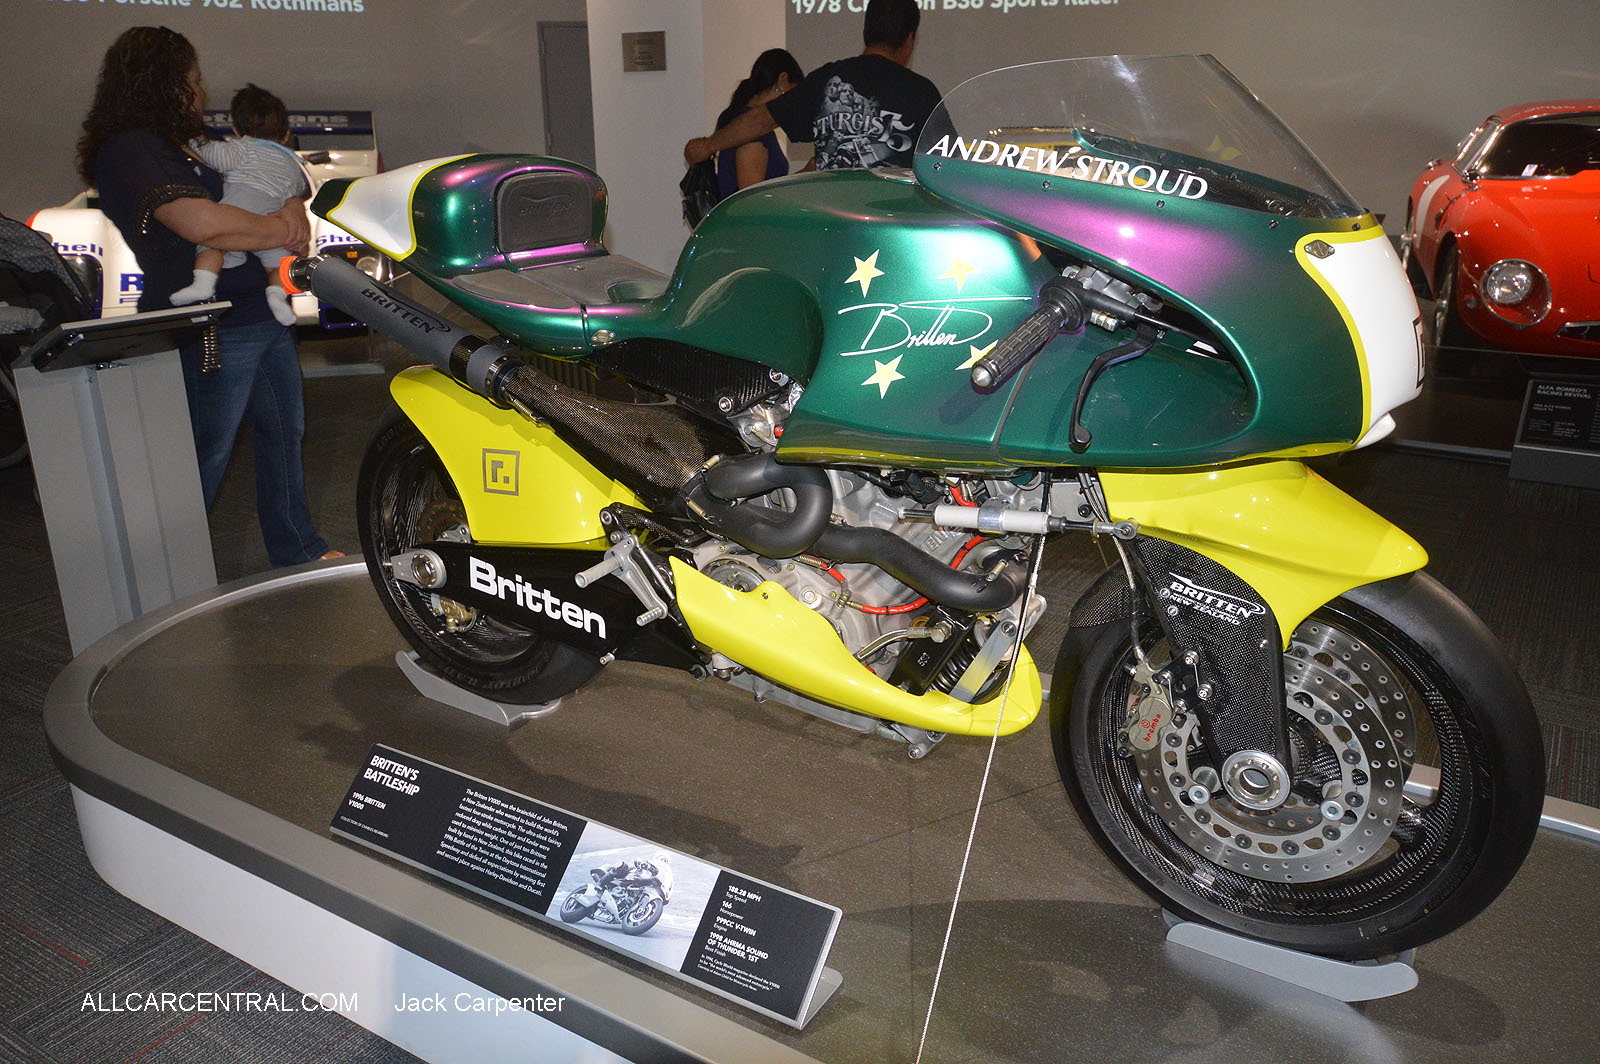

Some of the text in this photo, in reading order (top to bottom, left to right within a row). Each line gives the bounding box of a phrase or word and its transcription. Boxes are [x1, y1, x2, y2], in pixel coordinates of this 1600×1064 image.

[791, 0, 841, 14] 1978
[927, 134, 1208, 200] ANDREW STROUD
[315, 234, 358, 247] She
[53, 242, 103, 257] hell
[361, 287, 435, 334] BRITTEN
[838, 297, 1032, 356] Britten
[469, 556, 607, 639] Britten
[1169, 581, 1253, 618] BRITTEN
[1143, 713, 1161, 742] brembo
[370, 755, 419, 781] BRITTEN'S
[363, 768, 420, 795] BATTLESHIP
[349, 799, 364, 810] V1000
[364, 797, 386, 809] BRITTEN
[722, 901, 732, 909] 166
[734, 895, 747, 903] Speed
[747, 892, 761, 902] MPH
[720, 907, 744, 920] Horsepower
[713, 923, 727, 932] Engine
[716, 916, 756, 936] 999CC V-TWIN
[707, 938, 759, 963] OF THUNDER, 1ST
[714, 948, 726, 957] Finish
[723, 937, 745, 951] AHRMA
[746, 946, 768, 959] SOUND
